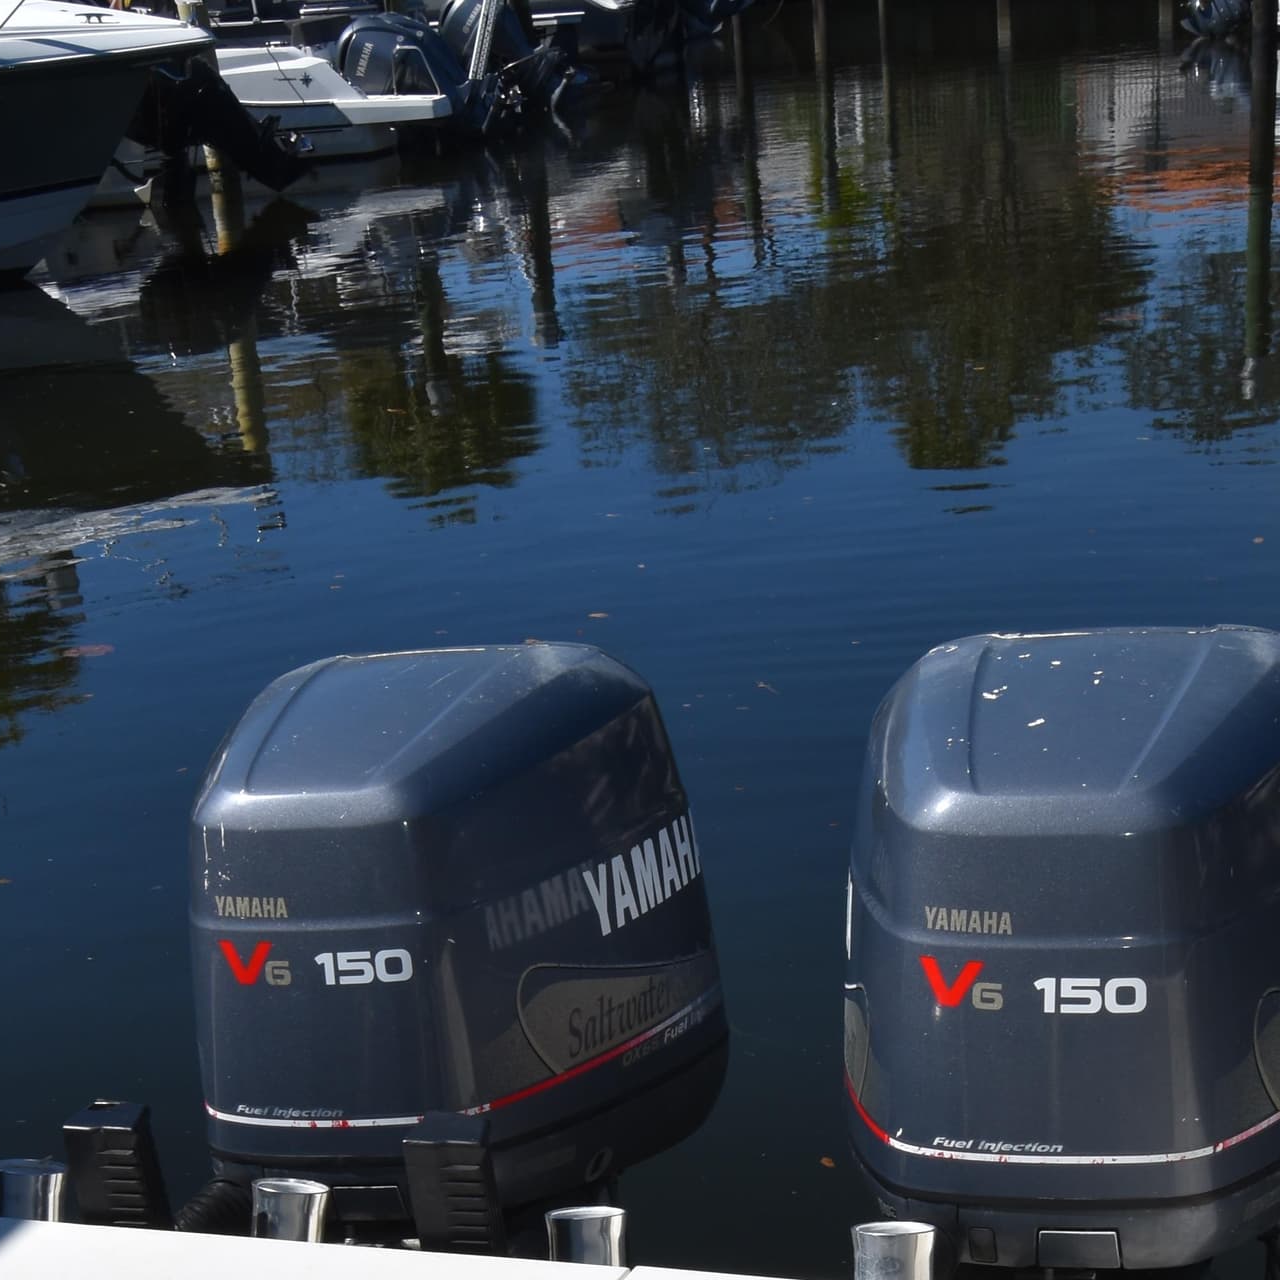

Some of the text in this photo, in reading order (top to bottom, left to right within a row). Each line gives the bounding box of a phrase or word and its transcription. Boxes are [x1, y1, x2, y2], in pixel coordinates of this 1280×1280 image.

[354, 41, 375, 78] YAMAHA
[215, 895, 289, 918] YAMAHA
[924, 906, 1013, 935] YAMAHA
[218, 939, 292, 986] V6
[314, 948, 414, 986] 150
[919, 955, 1004, 1010] V6
[1033, 977, 1147, 1014] 150
[568, 976, 672, 1059] Saltwater
[663, 1015, 689, 1045] Fuel
[236, 1104, 344, 1119] Fuel Injection
[932, 1136, 1064, 1153] Fuel Injection
